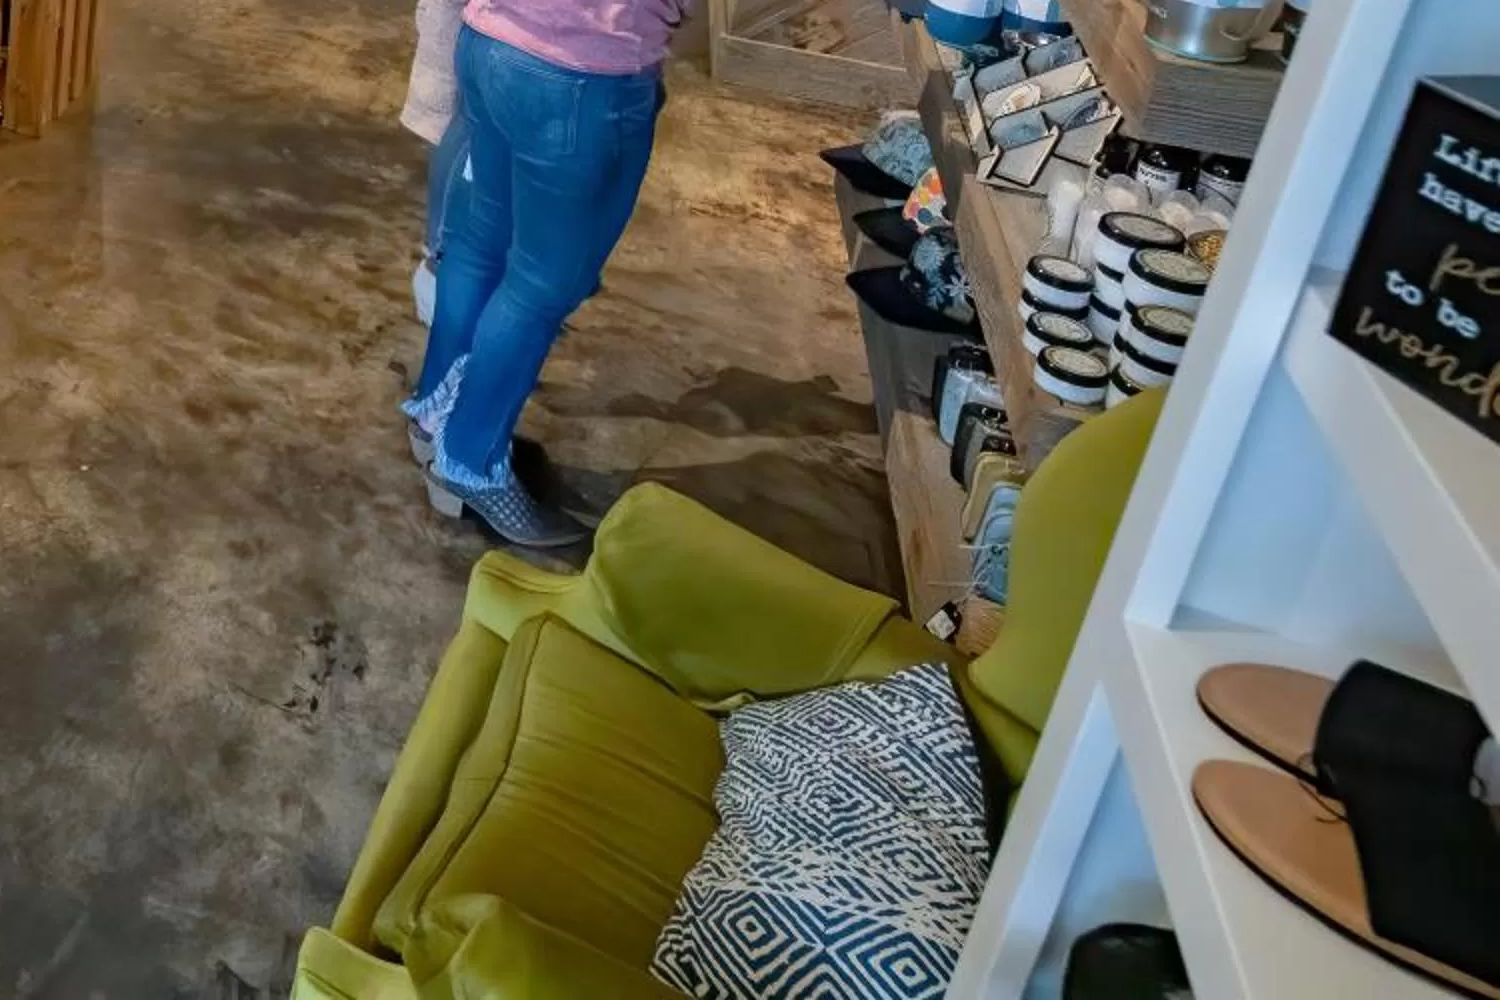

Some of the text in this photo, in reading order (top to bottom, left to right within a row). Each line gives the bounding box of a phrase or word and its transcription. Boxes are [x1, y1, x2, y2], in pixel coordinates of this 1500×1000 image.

[1432, 133, 1500, 188] Lif
[1385, 269, 1481, 339] to be
